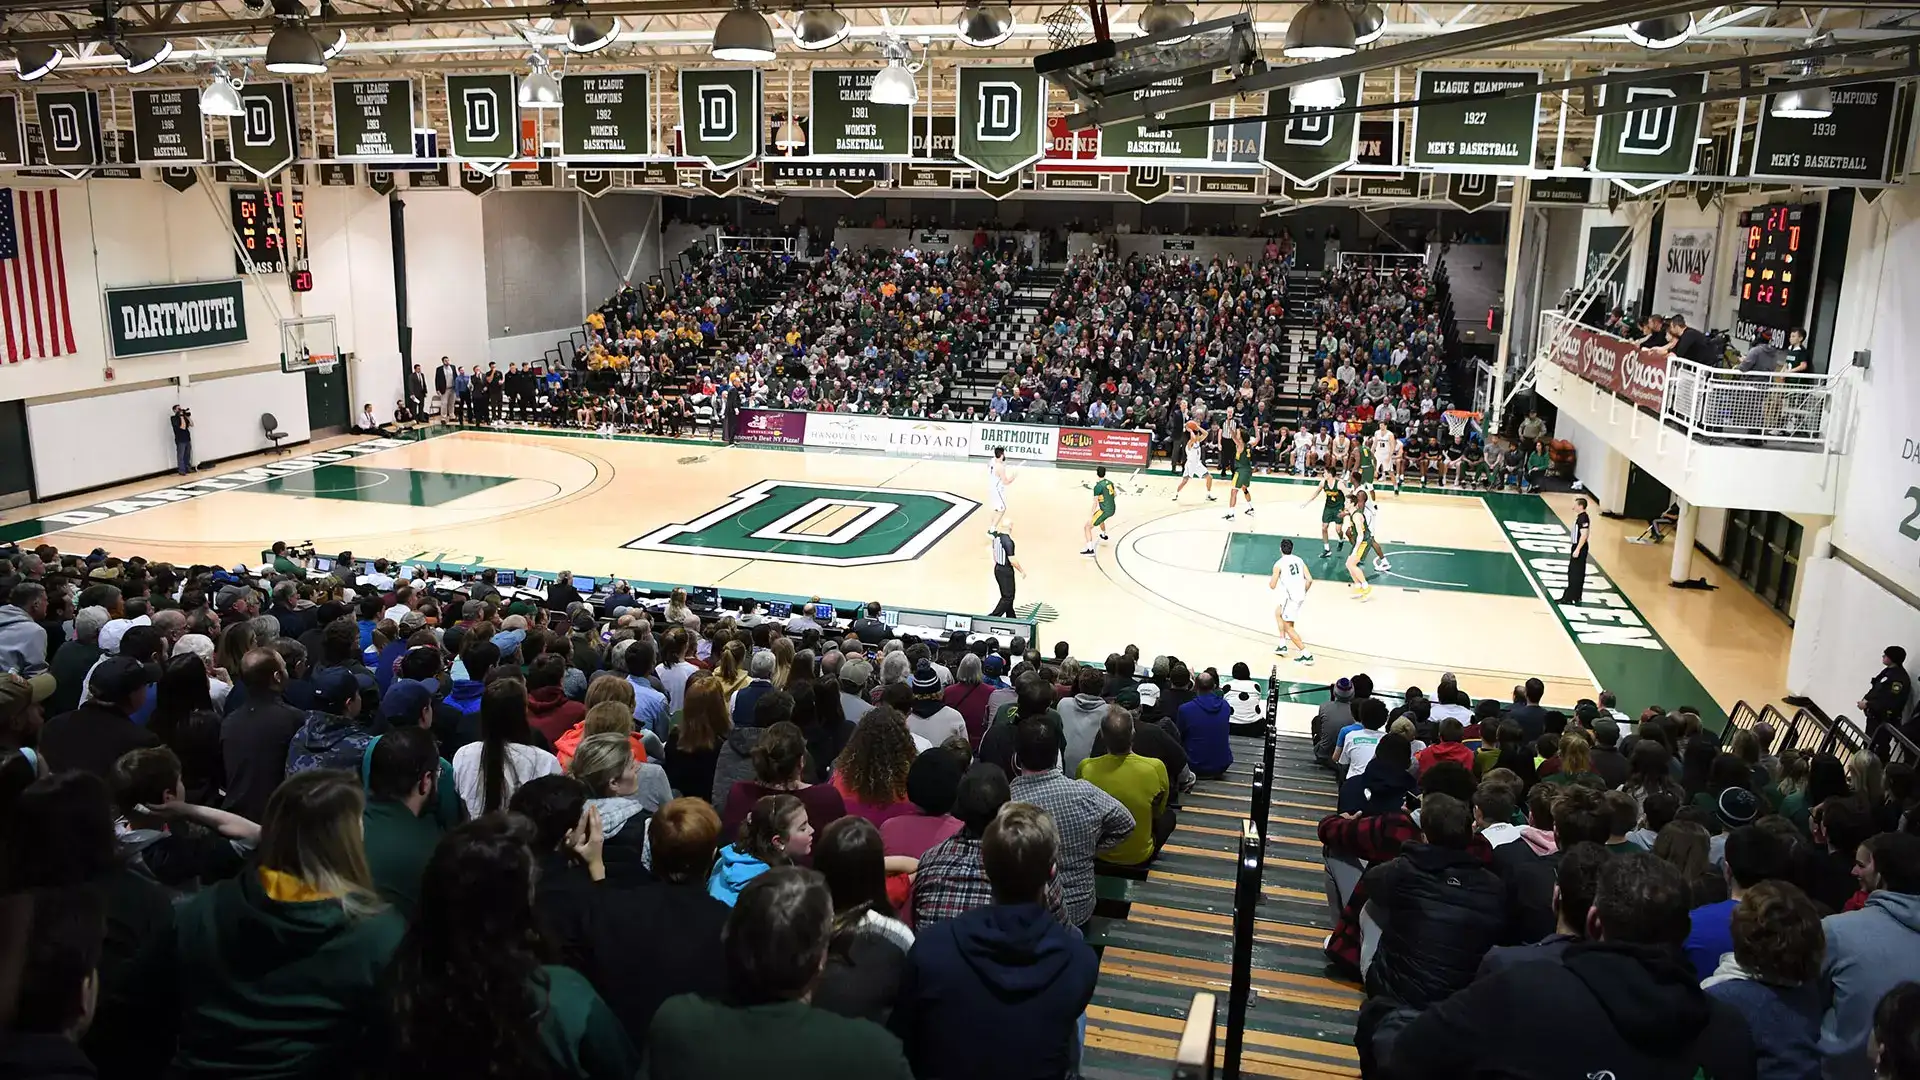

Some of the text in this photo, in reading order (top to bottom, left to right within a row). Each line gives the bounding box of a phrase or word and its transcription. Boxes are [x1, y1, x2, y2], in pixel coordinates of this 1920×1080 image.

[583, 79, 624, 90] IVY LEAGUE
[838, 75, 876, 87] IVY LEAG
[1433, 81, 1469, 94] LEAGUE
[353, 83, 390, 94] IVY LEAGUE
[150, 93, 182, 104] IVY LEAGUE
[355, 94, 388, 105] CHAMPIONS
[585, 93, 623, 104] CHAMPIONS
[1830, 91, 1879, 105] HAMPIONS
[152, 105, 182, 116] CHAMPIONS
[463, 87, 500, 142] D
[698, 84, 738, 142] D
[851, 107, 869, 118] 1981
[976, 81, 1022, 142] D
[1464, 112, 1487, 125] 1927
[1618, 87, 1678, 156] D
[49, 103, 82, 151] D
[590, 125, 619, 136] WOMEN'S
[845, 124, 877, 136] WOMEN'S
[1812, 123, 1837, 136] 1938
[157, 133, 181, 144] WOMEN'S
[361, 132, 387, 143] WOMEN'S
[836, 138, 884, 150] BASKETBALL
[355, 143, 394, 154] BASKETBALL
[583, 139, 626, 150] BASKETBALL
[1127, 141, 1182, 154] BASKETBALL
[1427, 141, 1519, 156] MEN'S BASKETBALL
[153, 147, 188, 157] BASKETBALL
[1771, 153, 1867, 170] MEN'S BASKETBALL
[779, 168, 876, 177] LEEDE ARENA
[1066, 179, 1092, 187] BASKETBALL
[241, 201, 256, 218] 64
[1789, 225, 1800, 251] 70
[1666, 248, 1711, 276] SKIWAY
[296, 272, 312, 289] 20
[121, 296, 237, 340] DARTMOUTH
[811, 431, 879, 442] HANOVER INN
[889, 432, 968, 449] LEDYARD
[981, 428, 1050, 445] DARTMOUTH
[984, 443, 1043, 455] BAKETBALL
[38, 437, 418, 525] DARTMOUTH
[618, 478, 983, 568] D
[1289, 563, 1300, 576] 21
